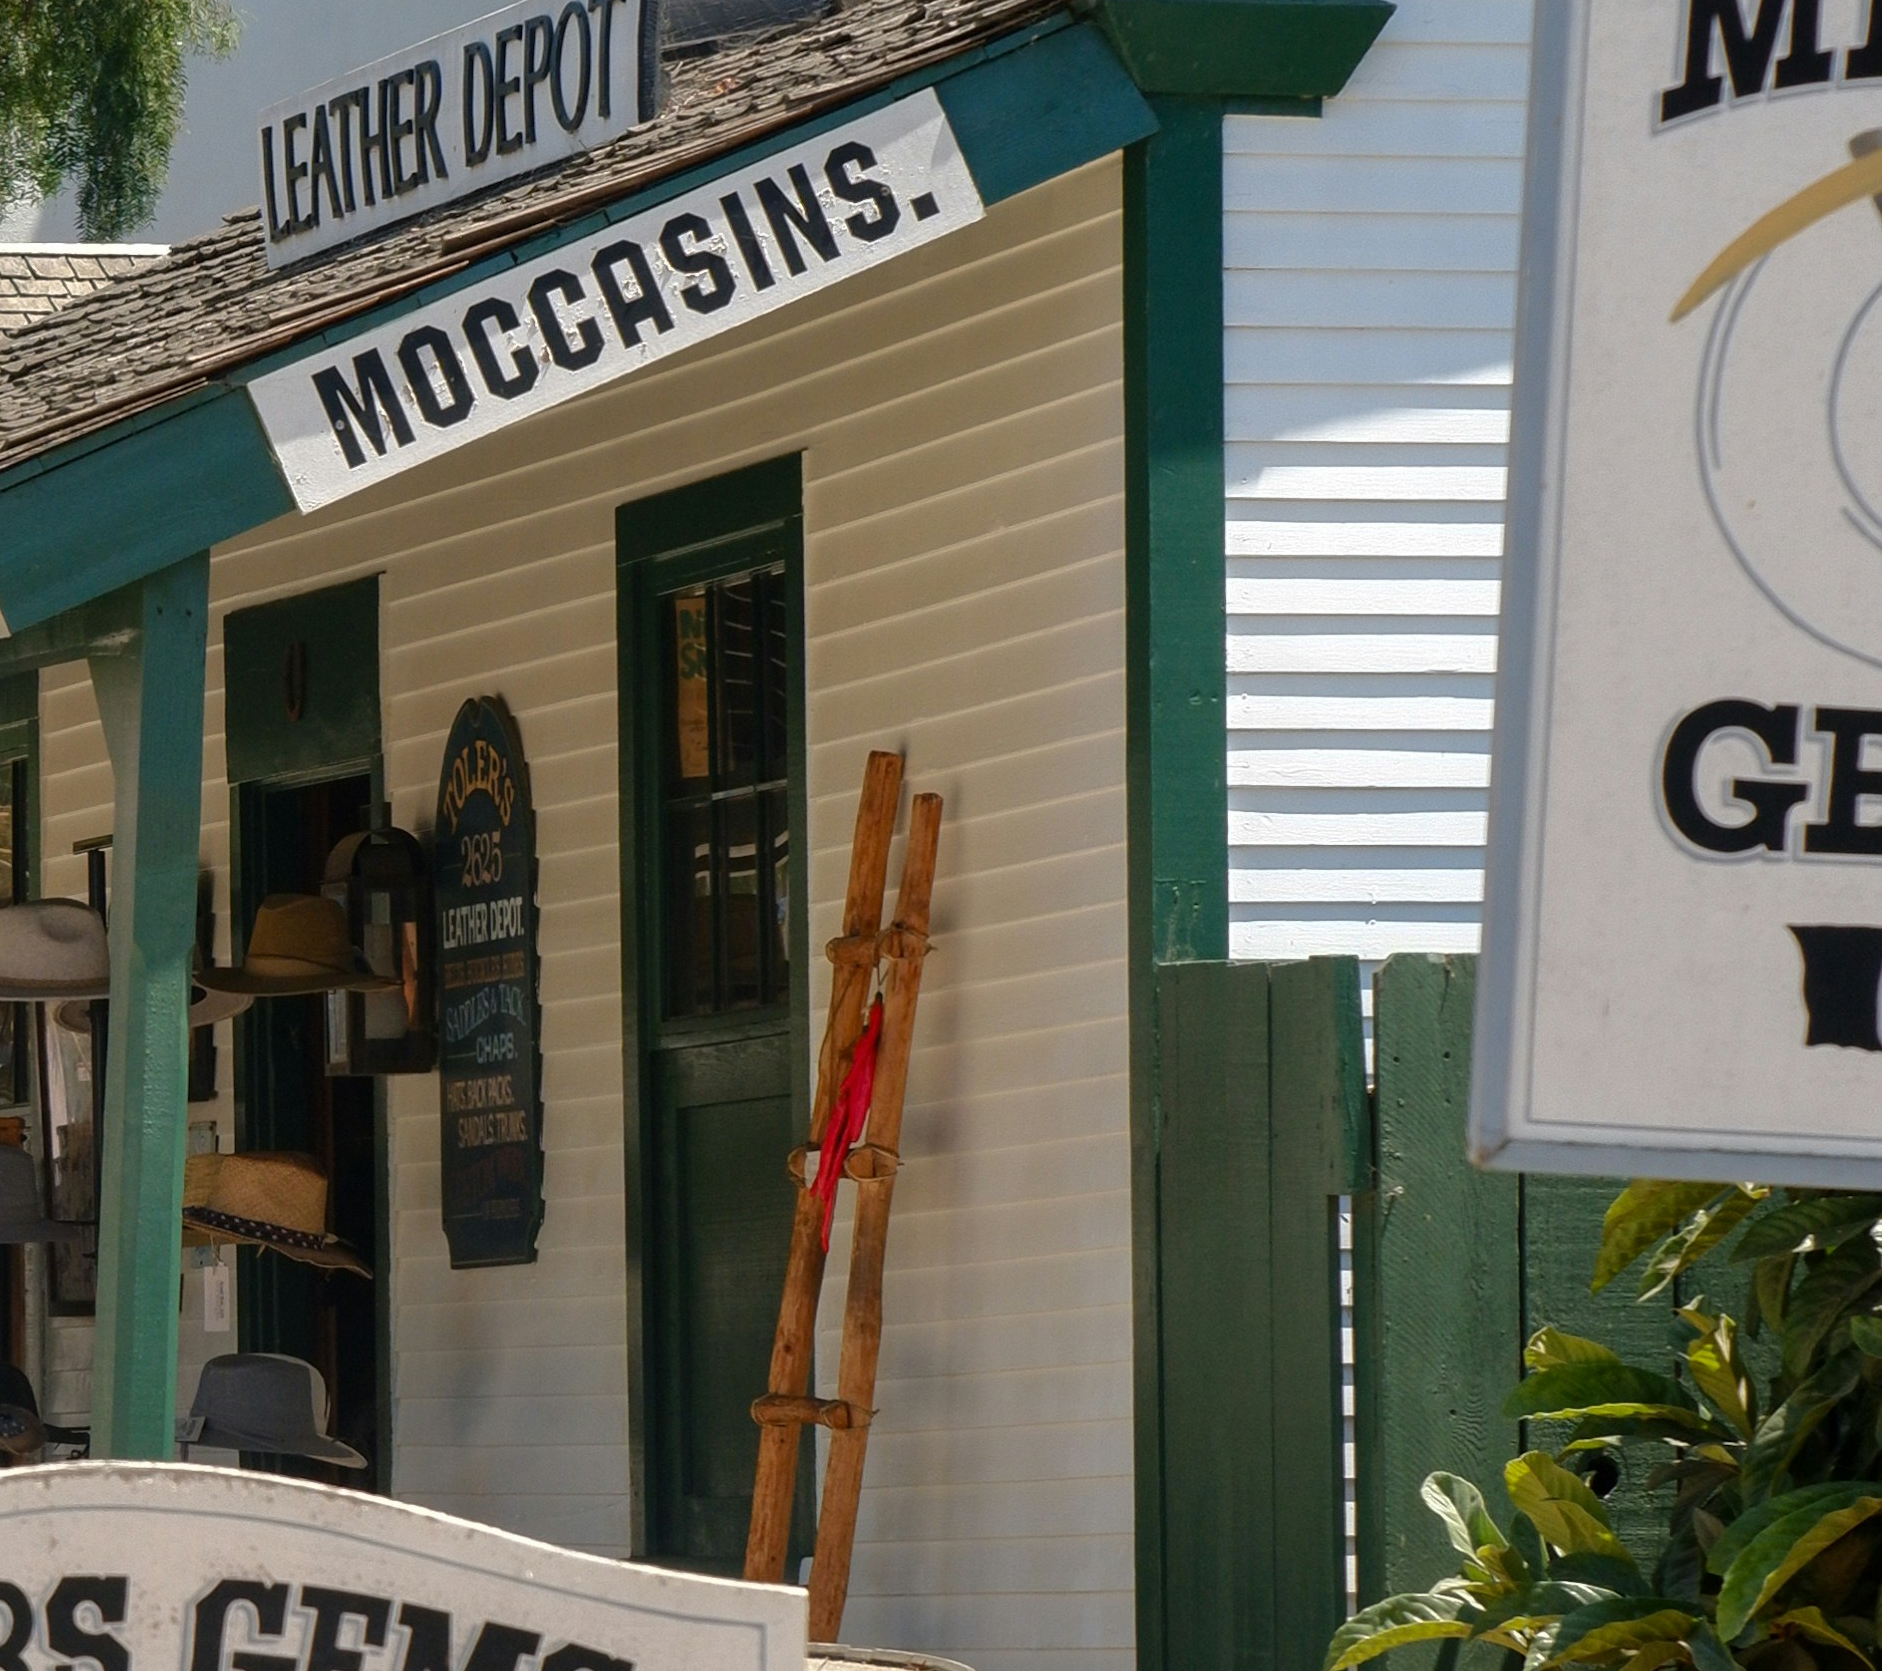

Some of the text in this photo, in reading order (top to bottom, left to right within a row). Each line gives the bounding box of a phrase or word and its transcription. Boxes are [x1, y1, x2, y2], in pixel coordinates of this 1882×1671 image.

[261, 57, 449, 243] LEATHER
[311, 140, 941, 471] MOCCASINS.
[443, 739, 515, 836] TOLER'S
[462, 830, 502, 887] 2625
[442, 896, 525, 950] LEATHER DEPOT.
